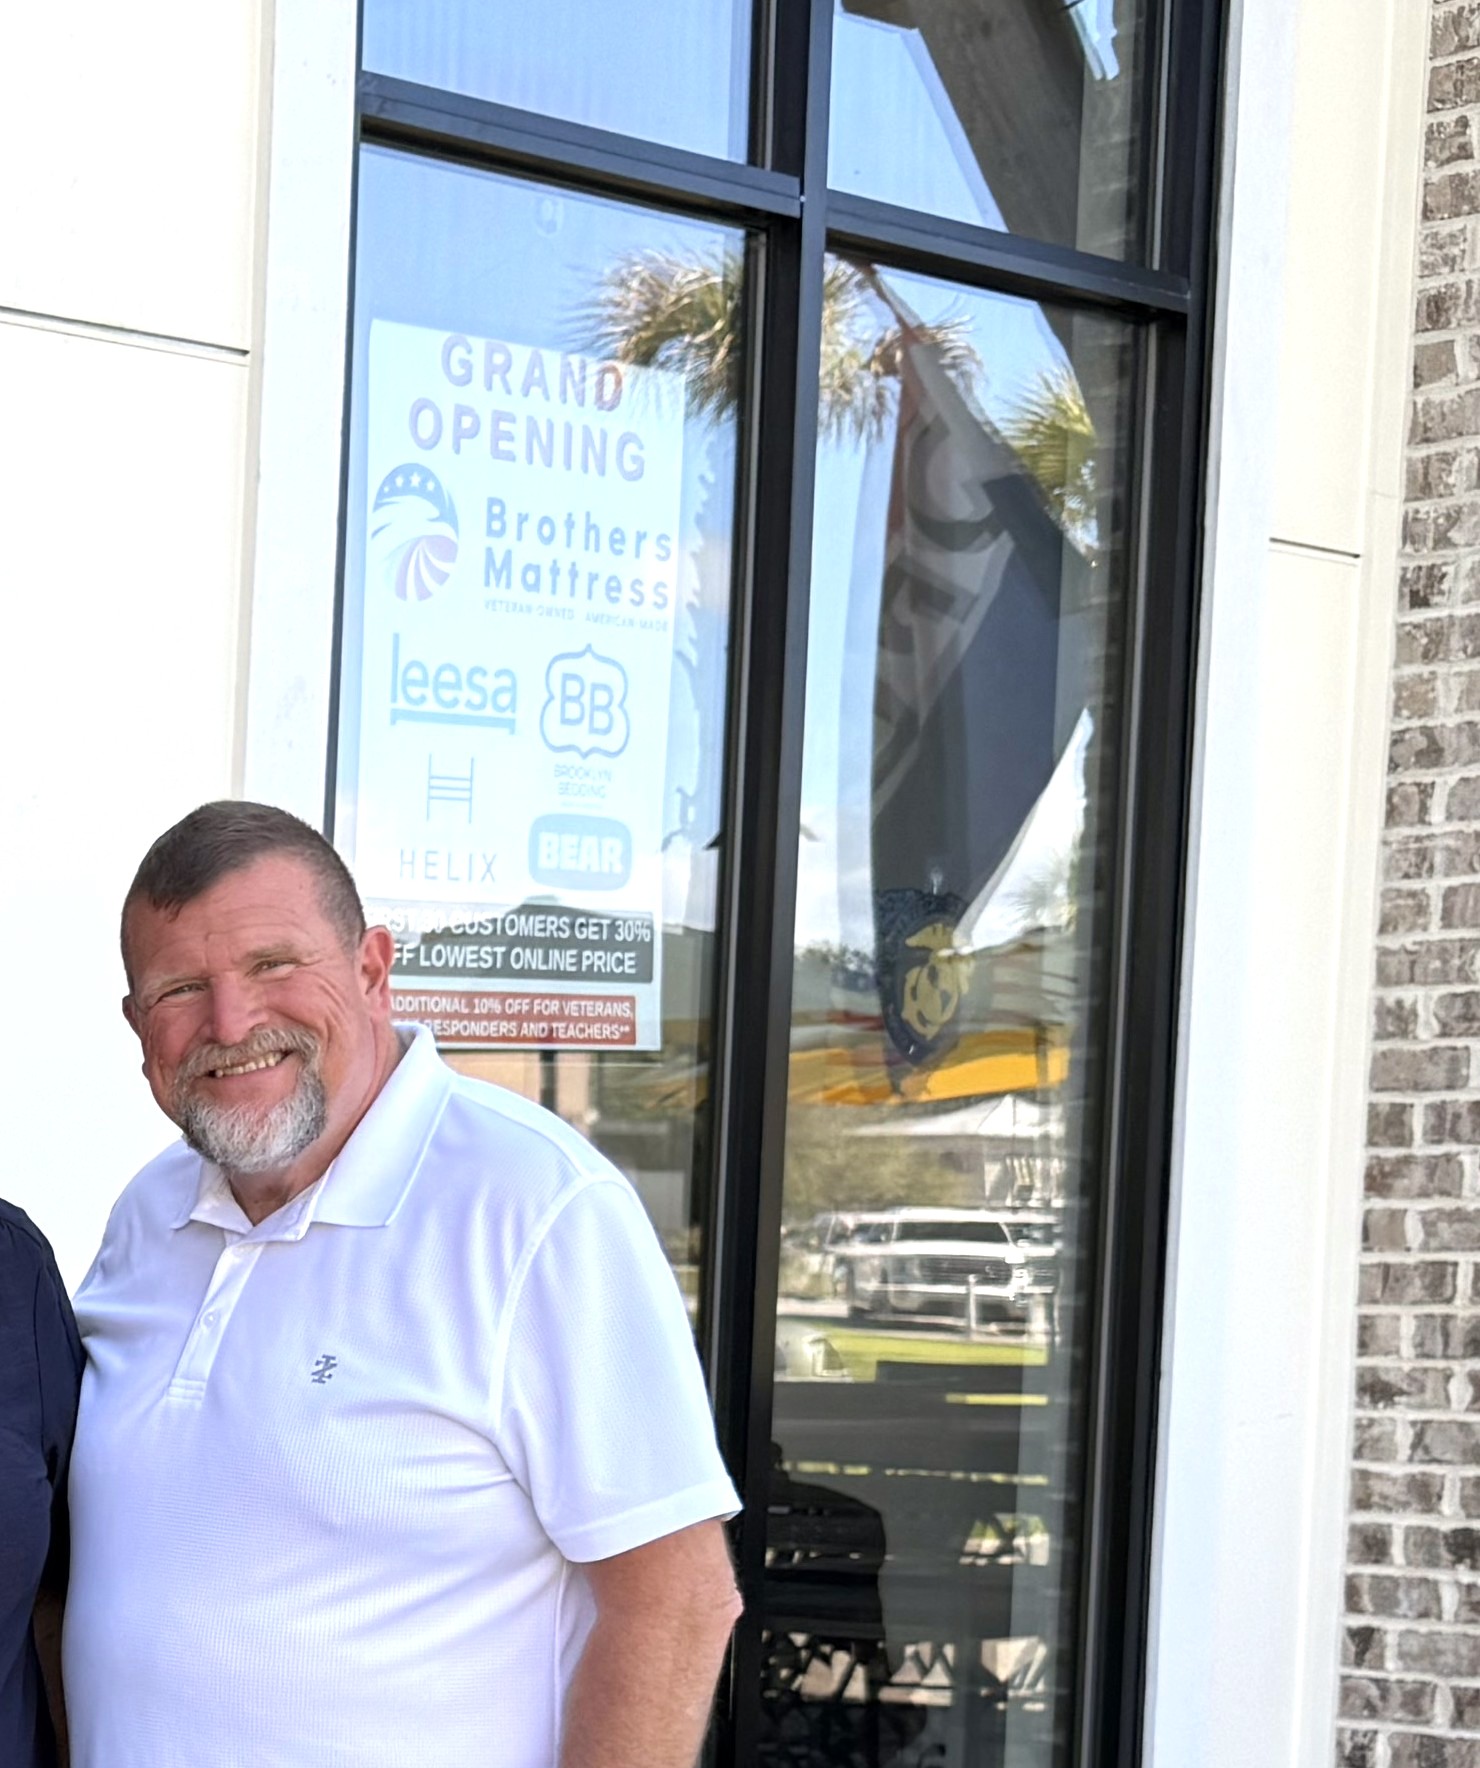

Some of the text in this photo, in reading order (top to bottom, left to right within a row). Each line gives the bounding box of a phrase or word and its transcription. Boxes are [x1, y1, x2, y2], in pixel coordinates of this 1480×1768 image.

[441, 333, 622, 412] GRAND
[408, 397, 645, 482] OPENING
[486, 496, 672, 562] Brothers
[484, 546, 668, 610] Mattress
[391, 632, 517, 713] leesa
[399, 848, 497, 883] HELIX
[538, 830, 624, 874] BEAR
[451, 907, 570, 939] CUSTOMERS
[574, 918, 610, 942] GET
[614, 919, 652, 943] 30%
[419, 943, 506, 969] LOWEST
[510, 946, 578, 972] ONLINE
[581, 951, 637, 974] PRICE
[473, 997, 502, 1015] 10%
[505, 998, 530, 1015] OFF
[533, 998, 559, 1016] FOR
[520, 1021, 547, 1037] AND
